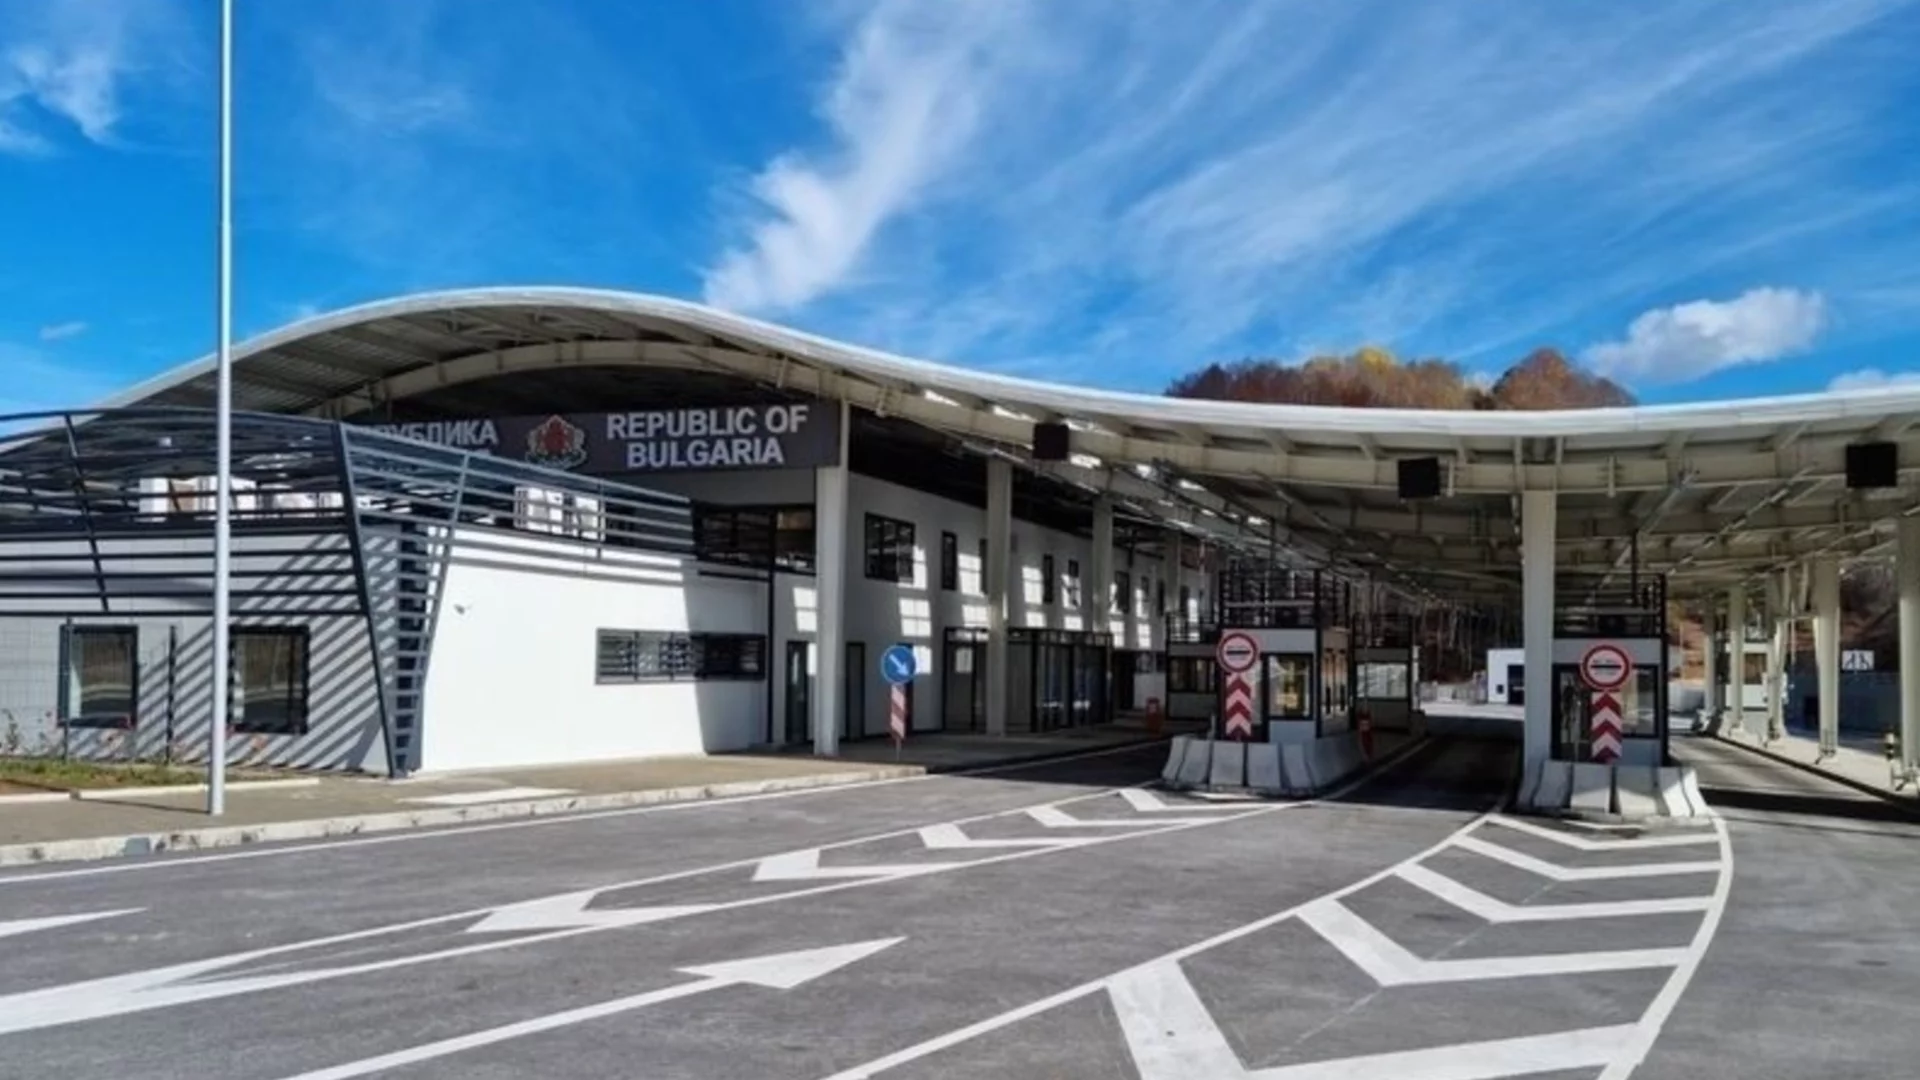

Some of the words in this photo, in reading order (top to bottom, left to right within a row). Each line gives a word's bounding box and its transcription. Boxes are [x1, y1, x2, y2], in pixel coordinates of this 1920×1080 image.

[607, 407, 756, 439] REPUBLIC
[765, 405, 809, 433] OF
[627, 437, 784, 468] BULGARIA
